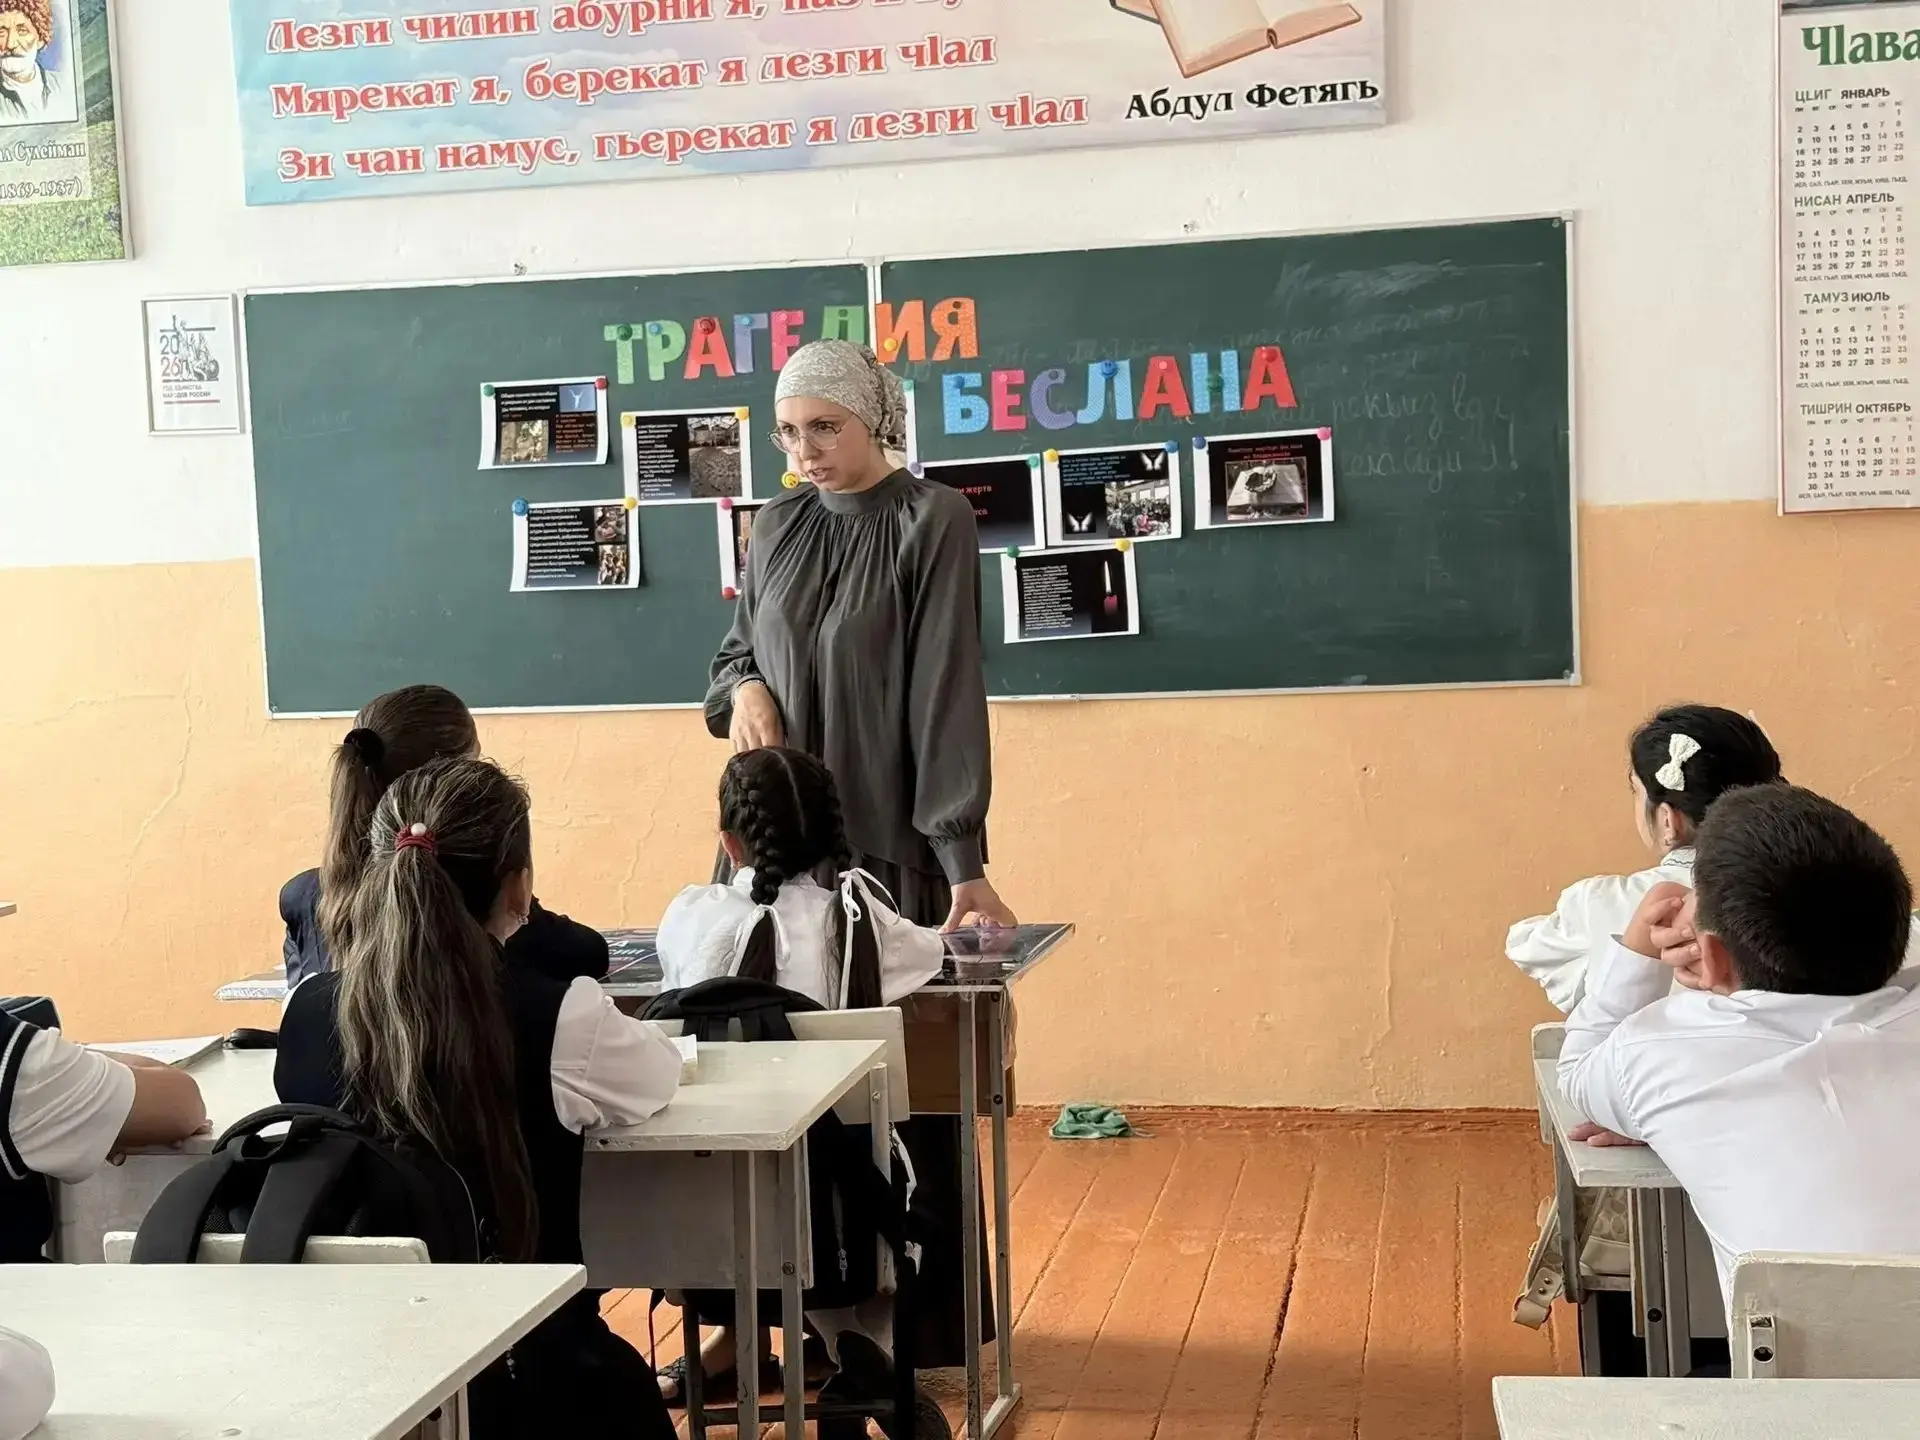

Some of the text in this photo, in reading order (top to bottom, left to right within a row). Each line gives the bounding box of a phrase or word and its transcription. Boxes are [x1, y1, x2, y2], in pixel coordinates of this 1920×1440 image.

[271, 20, 391, 52] Лезги
[404, 8, 539, 42] чилин
[552, 0, 713, 34] абурни
[273, 80, 458, 120] Мярекат
[471, 76, 508, 105] я,
[523, 59, 707, 103] берекат
[720, 59, 746, 83] я
[761, 47, 886, 80] лезги
[1840, 87, 1891, 100] ЯНВАРЬ
[1125, 80, 1380, 121] Абдул Фетягь
[14, 140, 86, 166] Сулейман
[281, 149, 332, 181] Зи
[346, 149, 424, 176] чан
[438, 138, 577, 174] намус,
[595, 122, 793, 163] гьерекат
[808, 119, 836, 144] я
[847, 108, 977, 139] лезги
[1794, 192, 1896, 207] НИСАН АПРЕЛЬ
[1804, 291, 1891, 305] ТАМУЗ ИЮЛЬ
[159, 334, 180, 355] 20
[160, 357, 181, 378] 26
[942, 345, 1298, 435] БЕСЛАНА
[1800, 402, 1912, 415] ТИШРИН ОКТЯБРЬ
